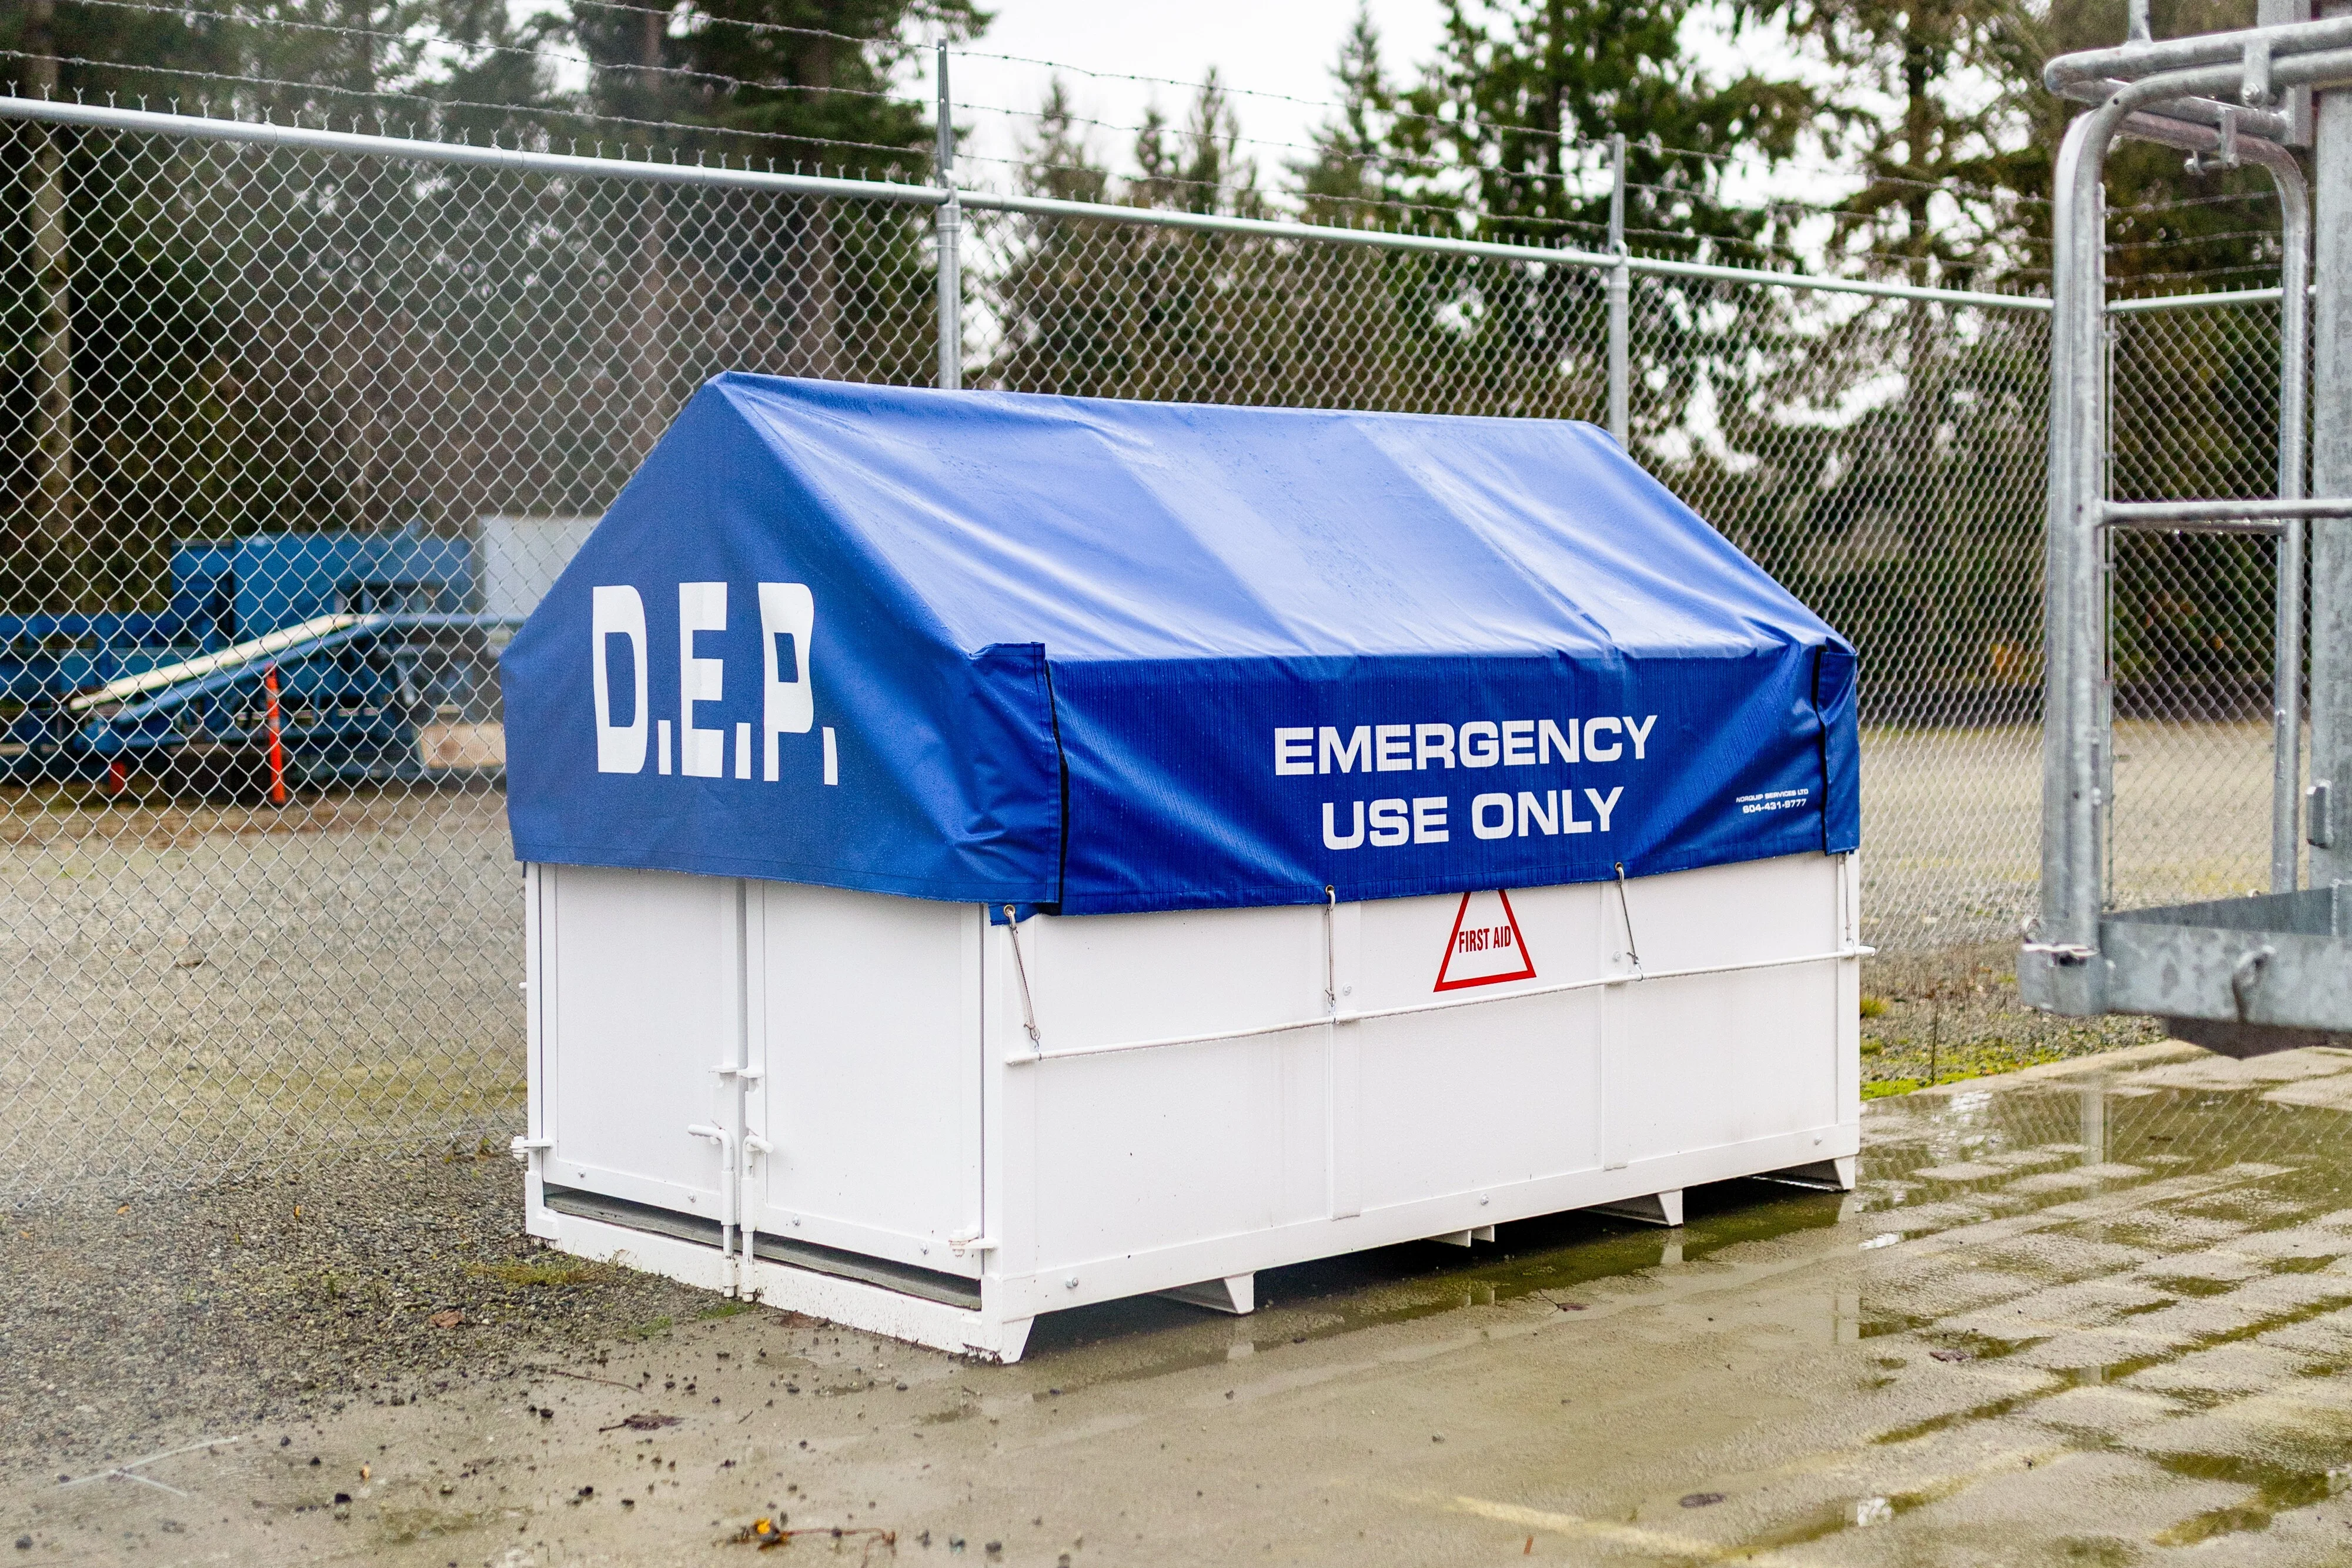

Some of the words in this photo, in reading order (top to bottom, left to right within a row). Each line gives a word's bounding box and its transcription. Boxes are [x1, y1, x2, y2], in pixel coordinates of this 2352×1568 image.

[593, 581, 838, 786] D.E.P.
[1274, 715, 1658, 775] EMERGENCY
[1322, 796, 1449, 850] USE
[1472, 787, 1624, 839] ONLY
[1736, 794, 1763, 803] NORQUIP
[1765, 790, 1796, 799] SERVICES
[1459, 928, 1490, 953] FIRST
[1494, 926, 1511, 948] AID
